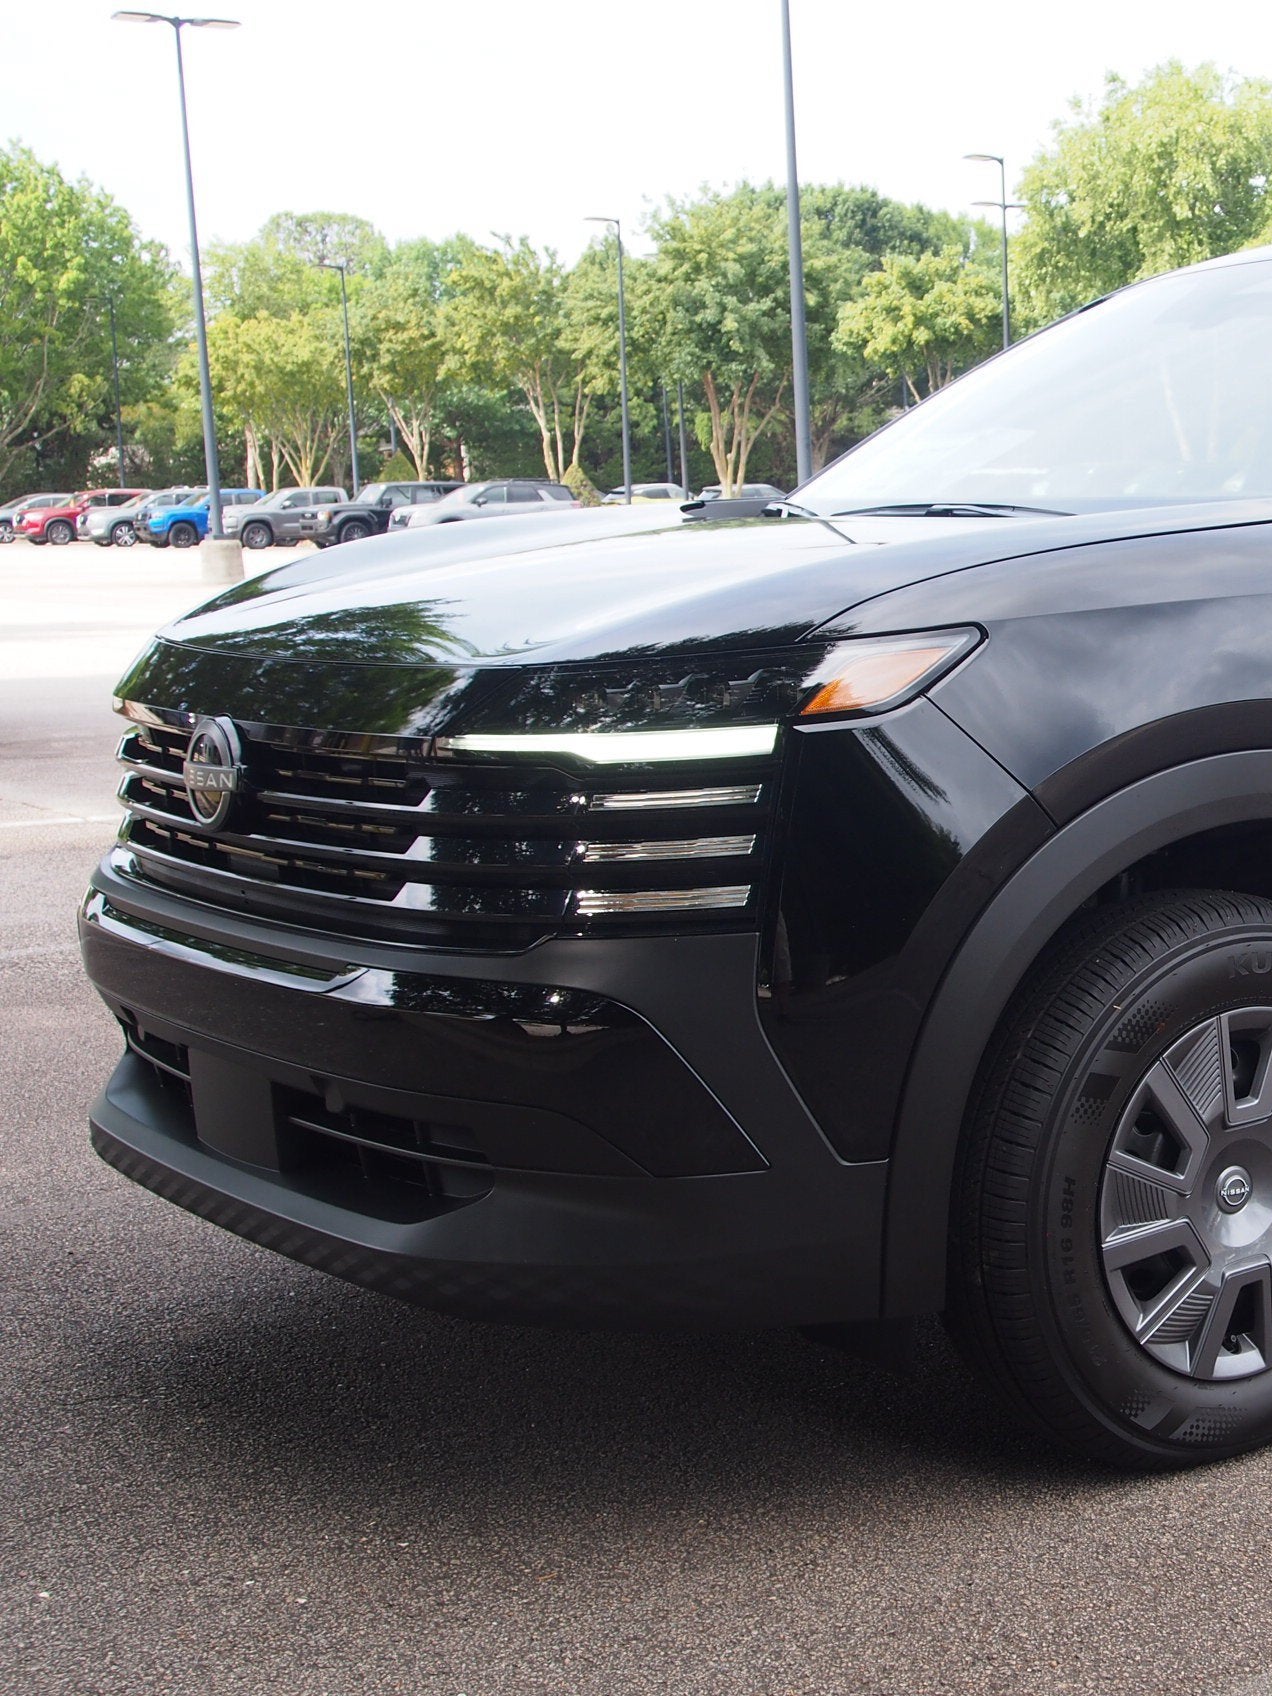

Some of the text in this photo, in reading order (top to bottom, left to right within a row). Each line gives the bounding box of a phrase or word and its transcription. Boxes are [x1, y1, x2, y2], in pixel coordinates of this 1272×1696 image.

[1060, 1175, 1077, 1229] 98H
[1220, 1185, 1250, 1197] NISSAN
[1060, 1238, 1077, 1286] R16
